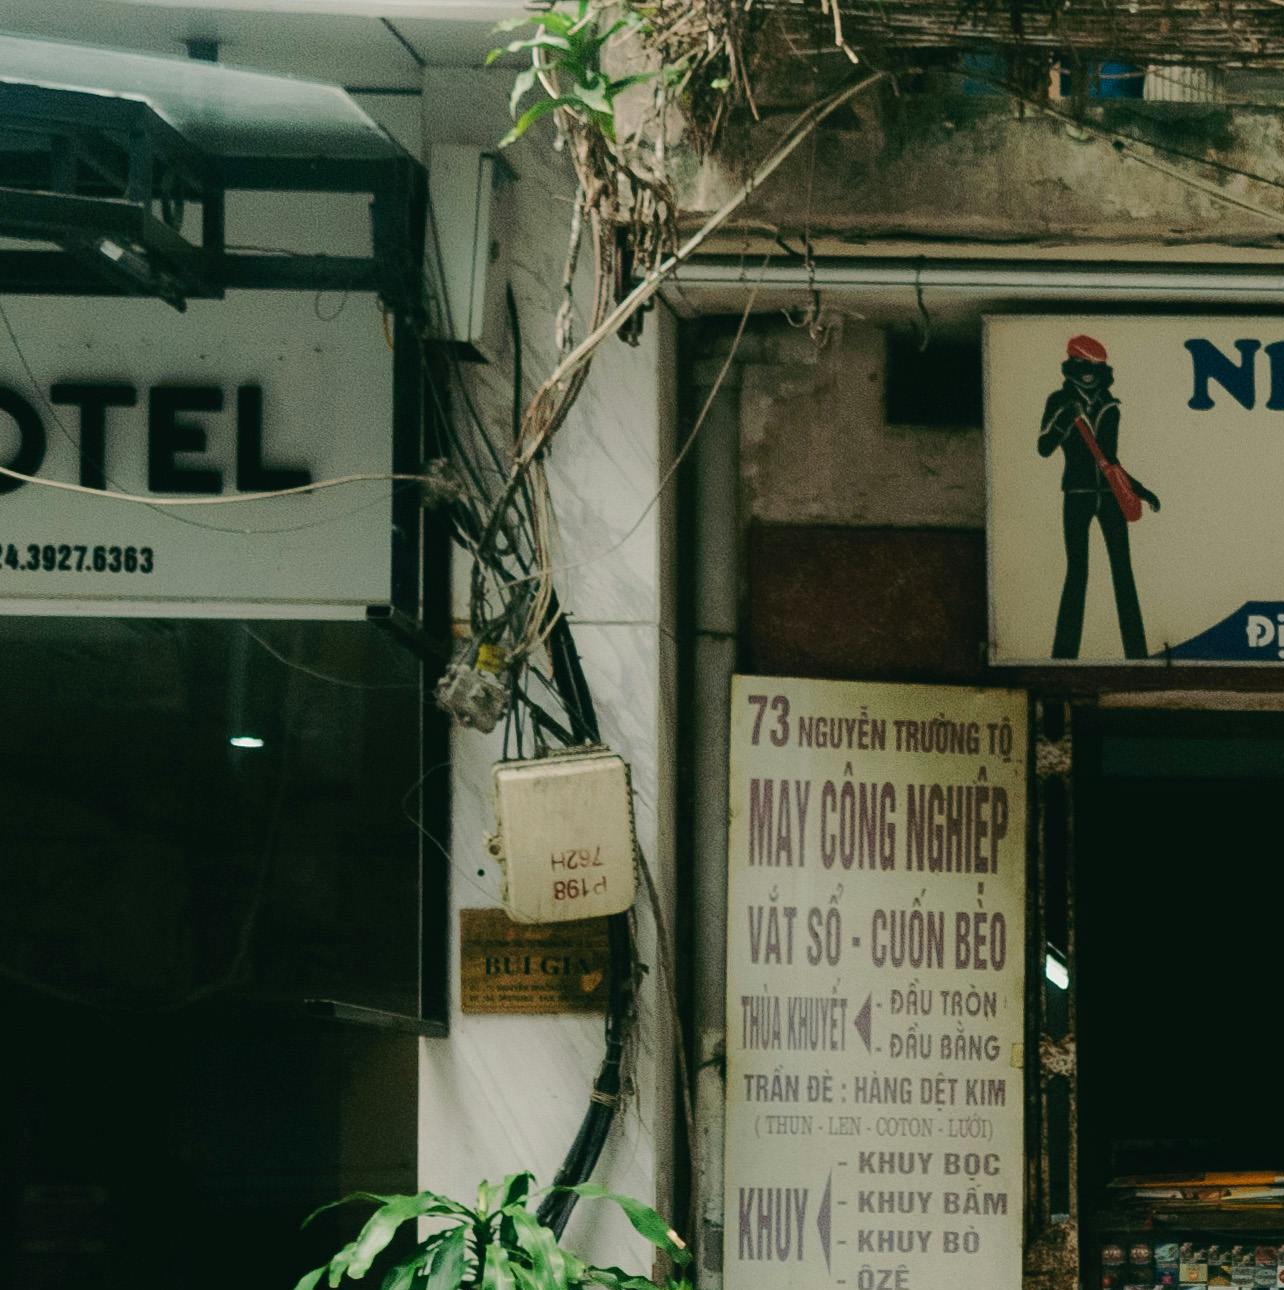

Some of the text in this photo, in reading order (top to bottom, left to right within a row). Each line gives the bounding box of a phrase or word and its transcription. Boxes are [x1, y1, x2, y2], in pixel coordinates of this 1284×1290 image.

[0, 543, 154, 574] 4.3927.6363
[748, 694, 791, 748] 73
[748, 778, 811, 868] MAY
[820, 761, 897, 871] CÔNG
[854, 1070, 912, 1105] HÀNG
[965, 1079, 1006, 1107] KIM
[828, 1116, 862, 1137] LEN
[875, 1117, 934, 1137] COTON
[858, 1151, 1001, 1181] KHUY BỌC
[858, 1191, 933, 1215] KHUY
[738, 1187, 809, 1262] KHUY
[858, 1231, 933, 1254] KHUY
